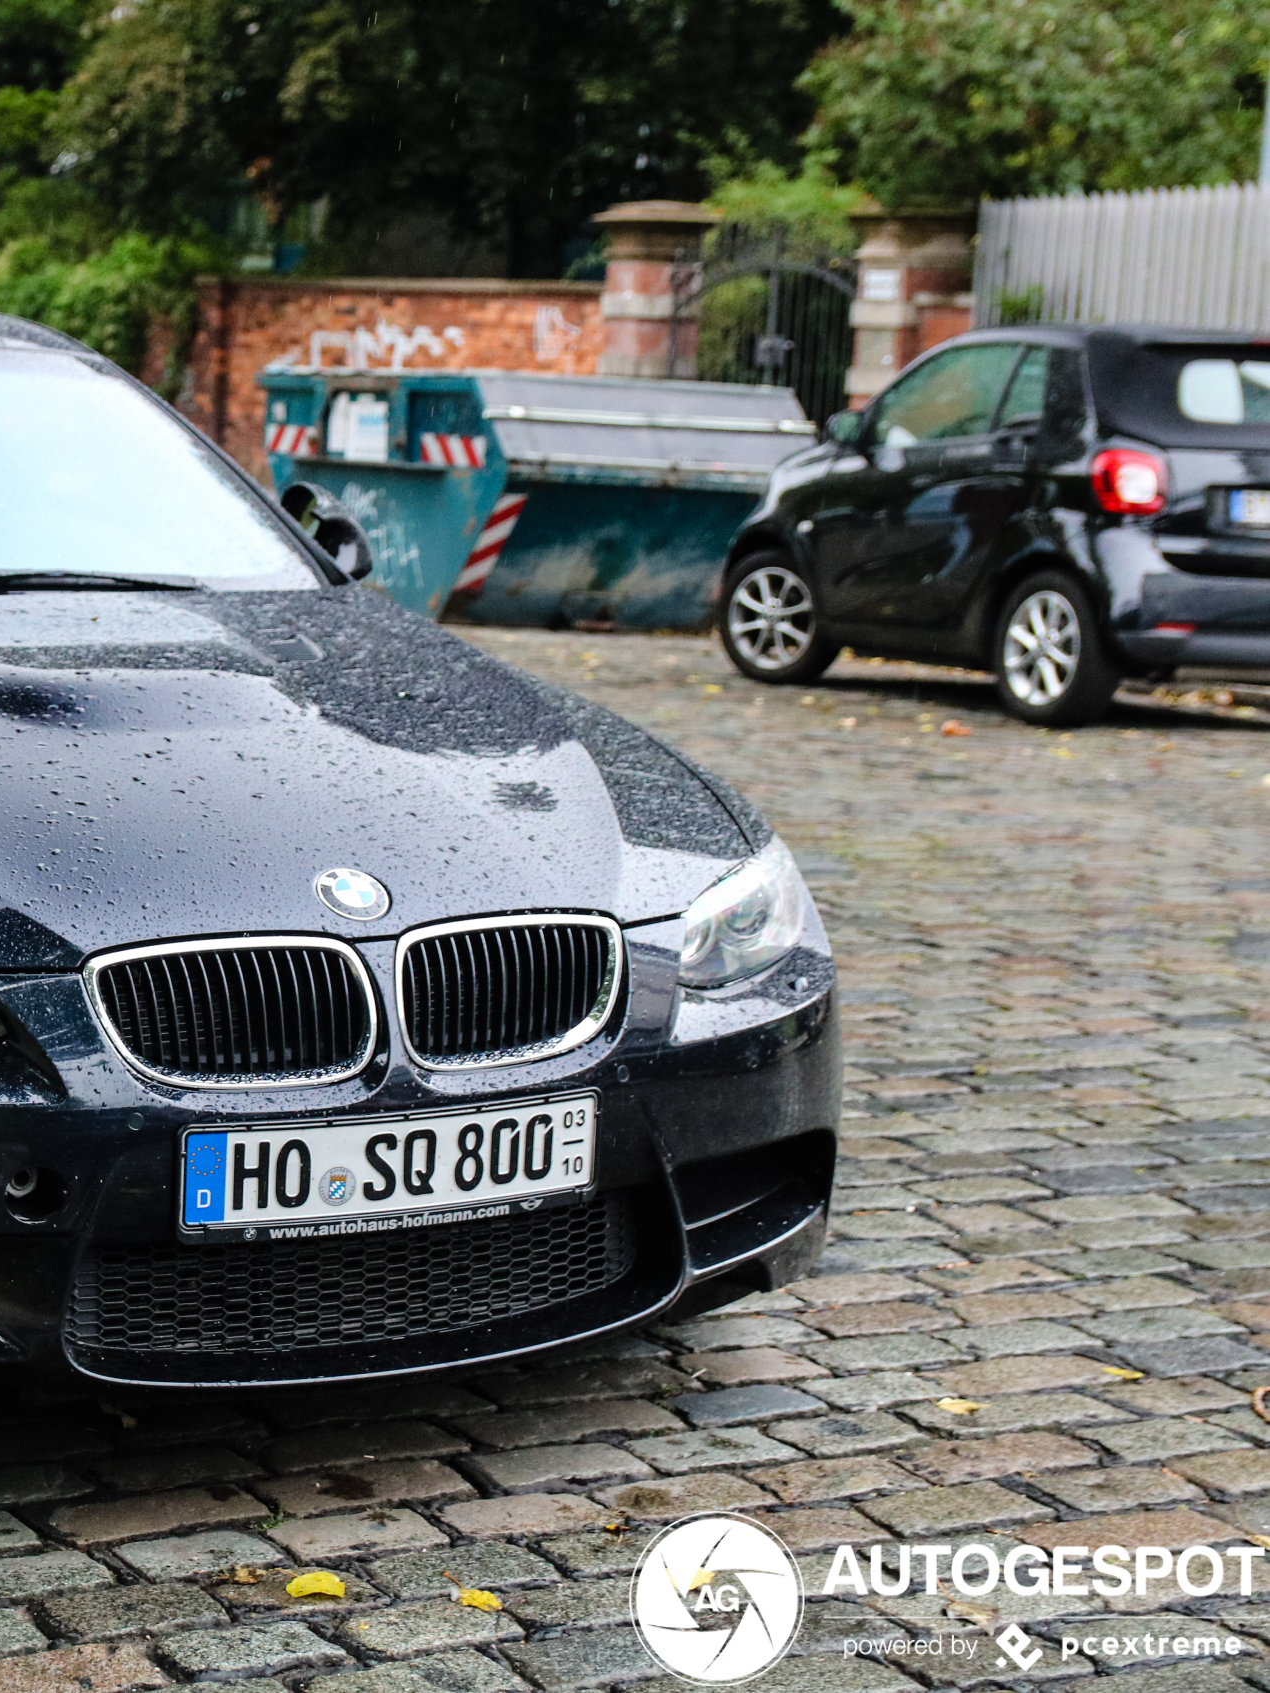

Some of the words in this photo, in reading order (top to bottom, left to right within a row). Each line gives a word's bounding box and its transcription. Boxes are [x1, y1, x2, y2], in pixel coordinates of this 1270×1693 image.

[563, 1108, 585, 1129] 03
[233, 1140, 311, 1210] HO
[363, 1129, 436, 1201] SQ
[455, 1114, 554, 1191] 800
[562, 1155, 583, 1176] 10
[197, 1189, 212, 1209] D
[269, 1203, 510, 1239] www.autohaus-hofmann.com
